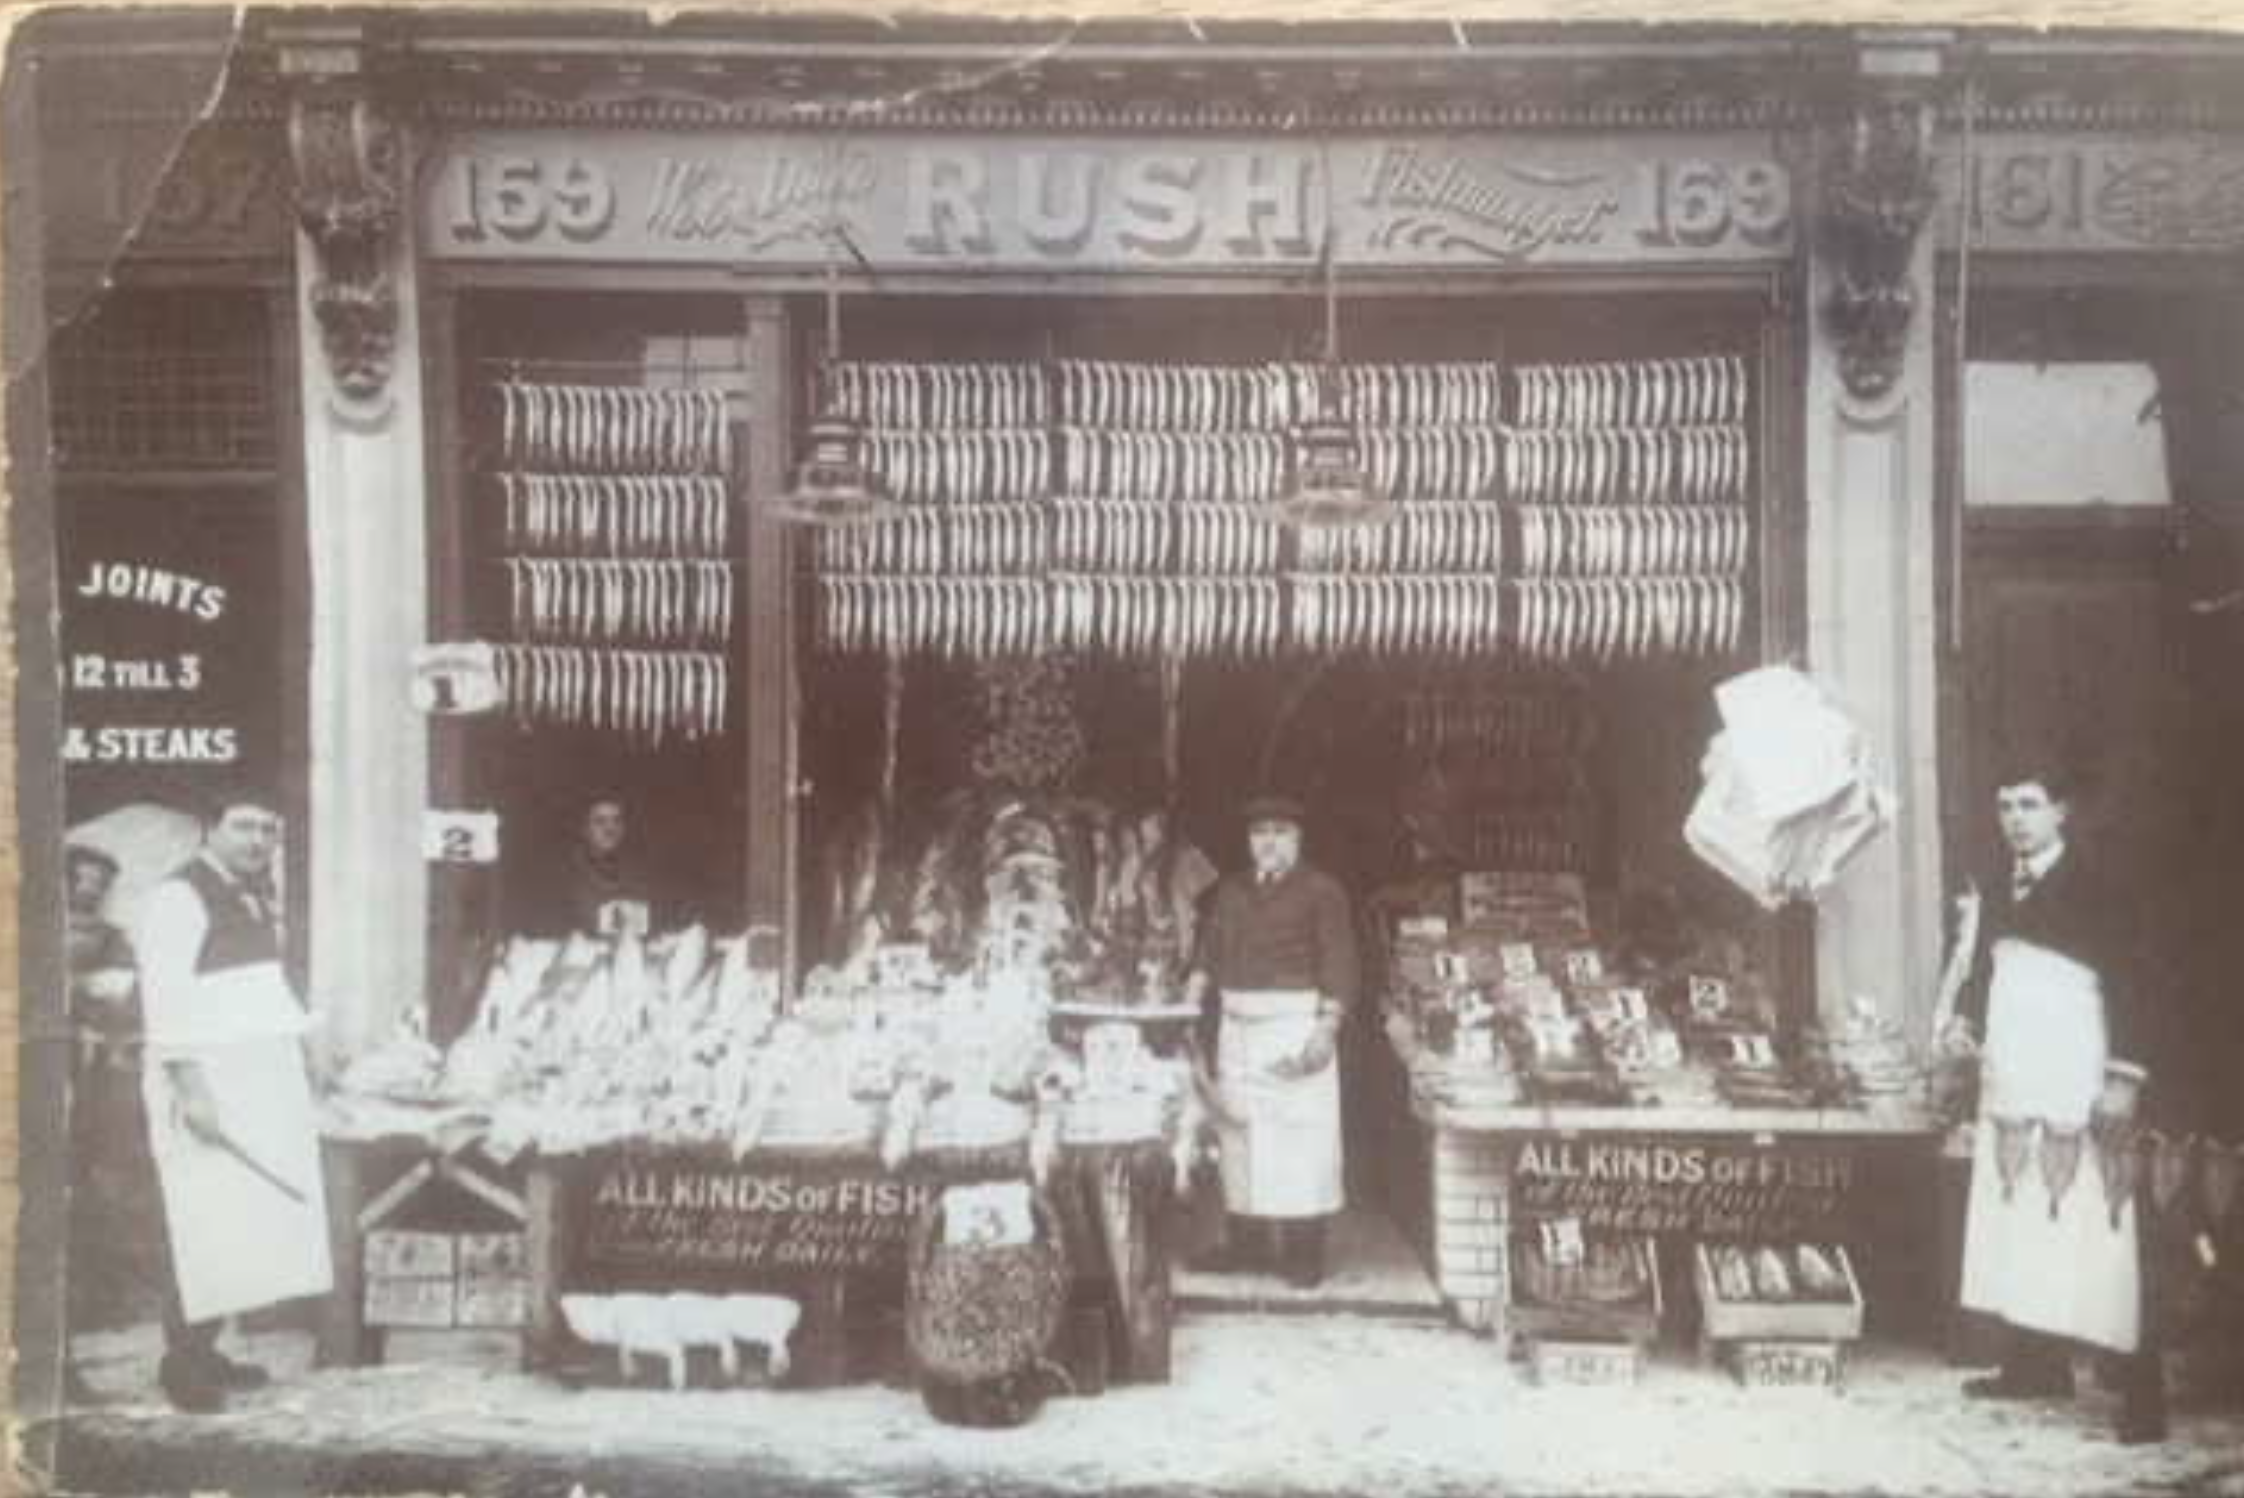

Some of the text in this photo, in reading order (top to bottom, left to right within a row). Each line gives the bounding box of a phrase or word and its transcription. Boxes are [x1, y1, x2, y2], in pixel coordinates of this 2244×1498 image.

[447, 155, 616, 244] 159
[903, 150, 1318, 256] RUSH
[79, 562, 226, 621] JOINTS
[73, 654, 200, 689] 12 TILL 3
[62, 727, 237, 760] & STEAKS
[1516, 1143, 1582, 1177] ALL
[598, 1174, 668, 1206] ALL
[837, 1178, 932, 1216] FISH
